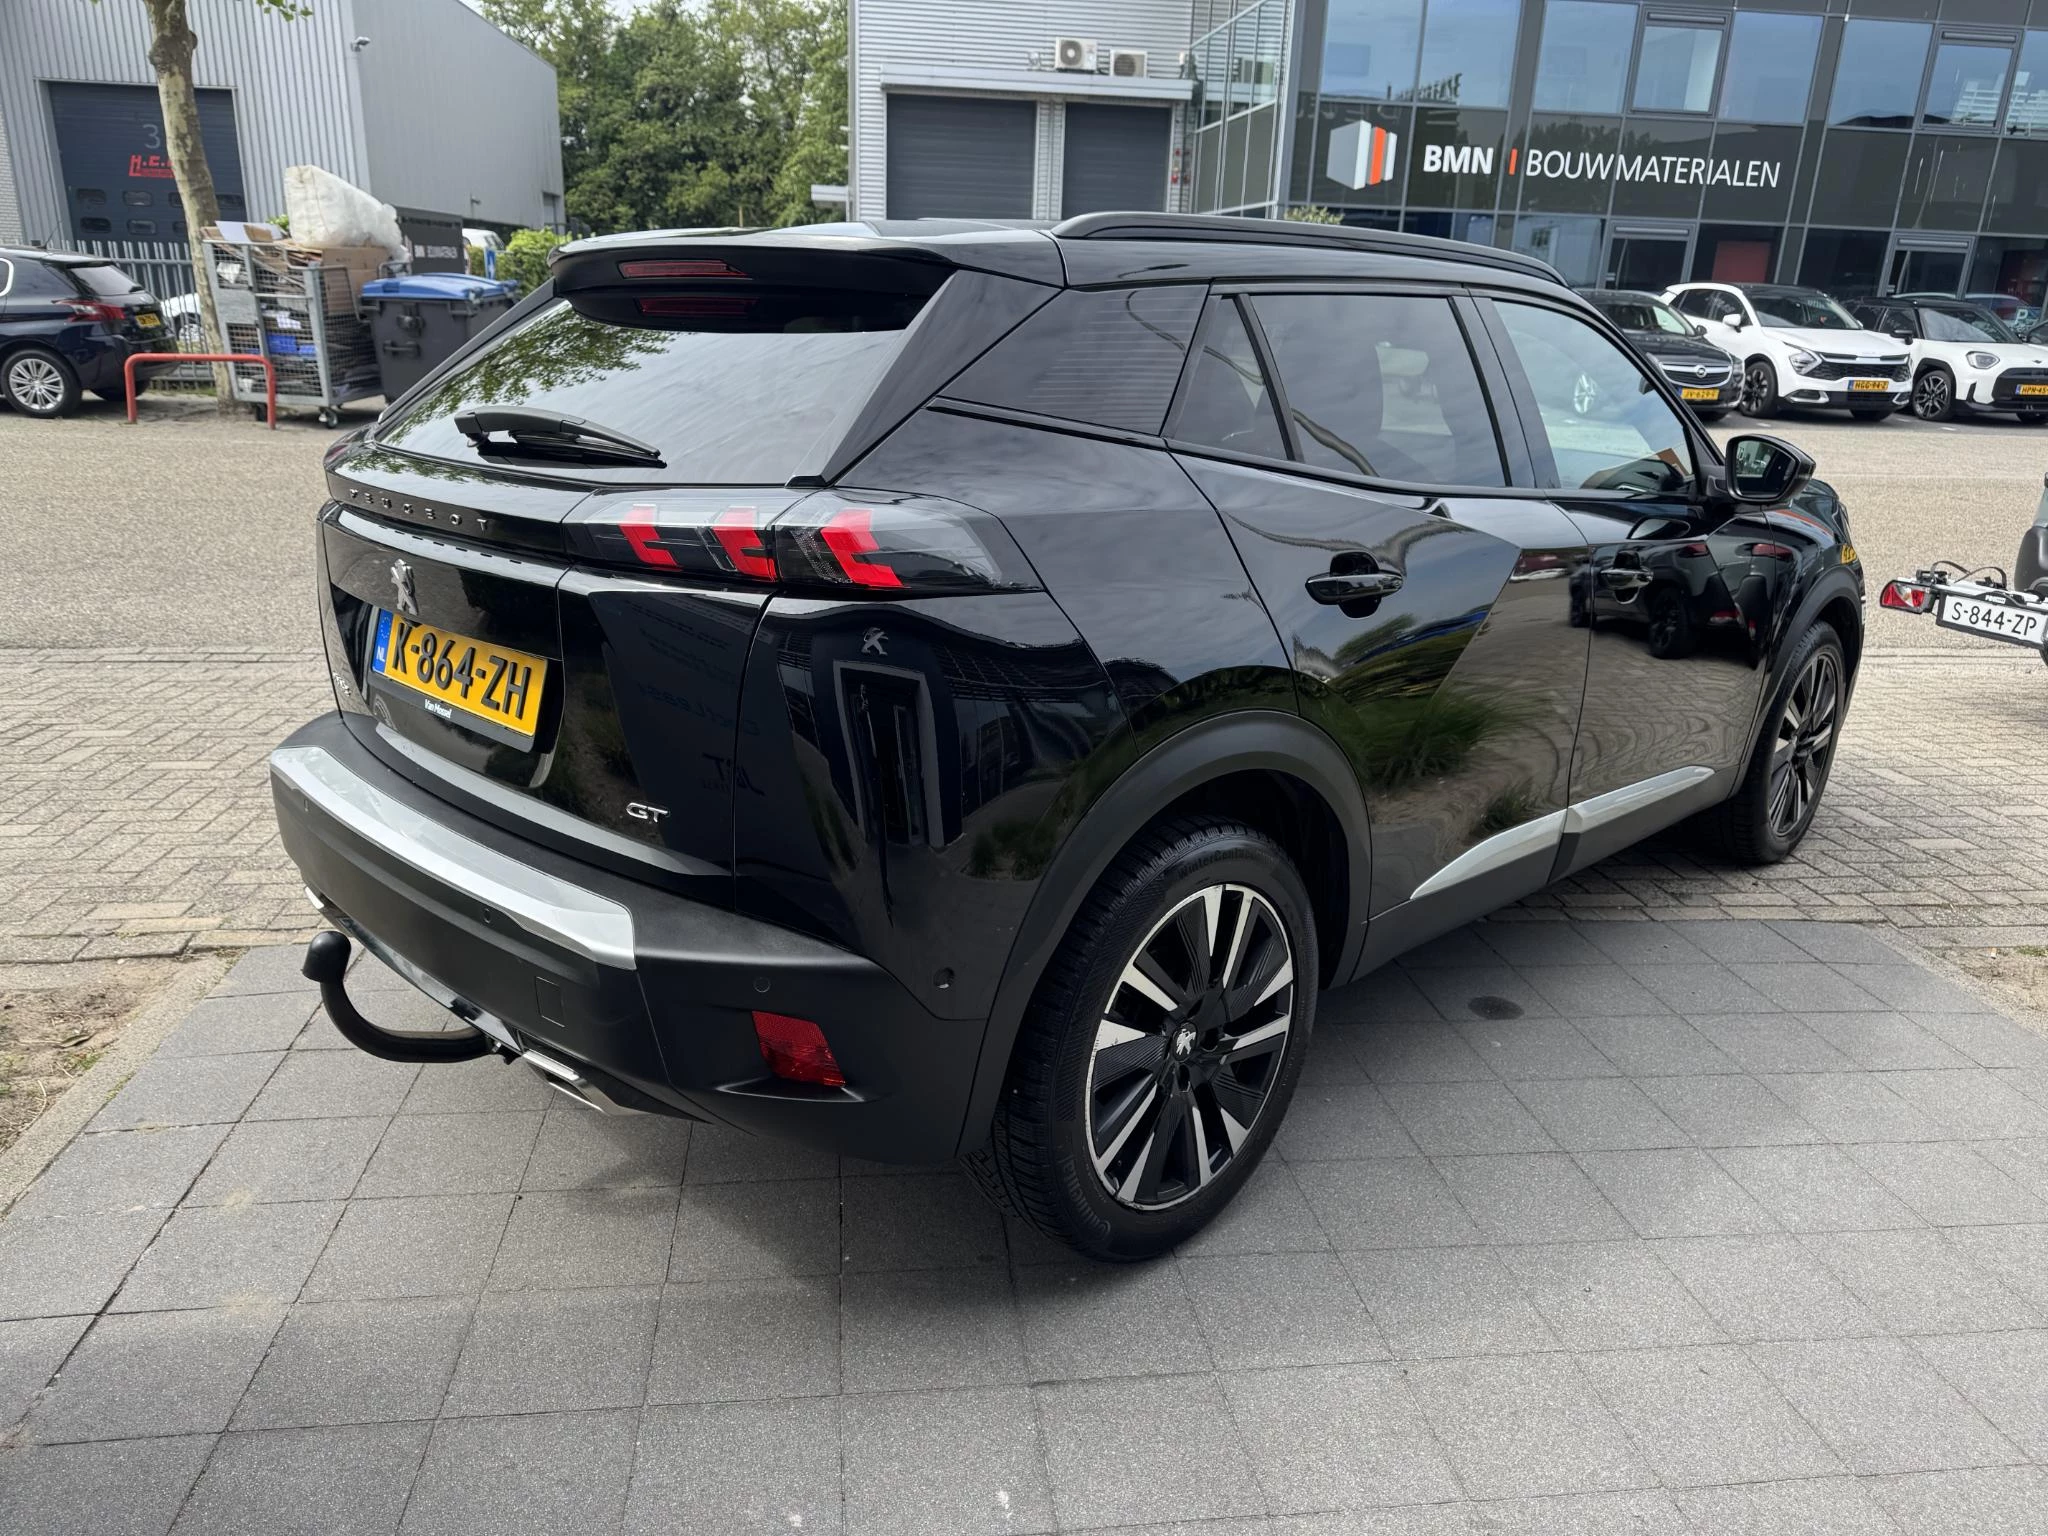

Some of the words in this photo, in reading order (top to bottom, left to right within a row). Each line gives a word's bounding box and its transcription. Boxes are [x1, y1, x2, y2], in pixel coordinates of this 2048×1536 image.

[142, 124, 161, 149] 3
[1423, 144, 1494, 176] BMN
[1526, 148, 1781, 189] BOUWMATERIALEN
[350, 488, 487, 532] PEUGEOT
[1951, 602, 2037, 636] S-844-ZP
[376, 646, 386, 662] NL
[391, 622, 532, 721] K-864-ZH
[626, 802, 669, 823] GT
